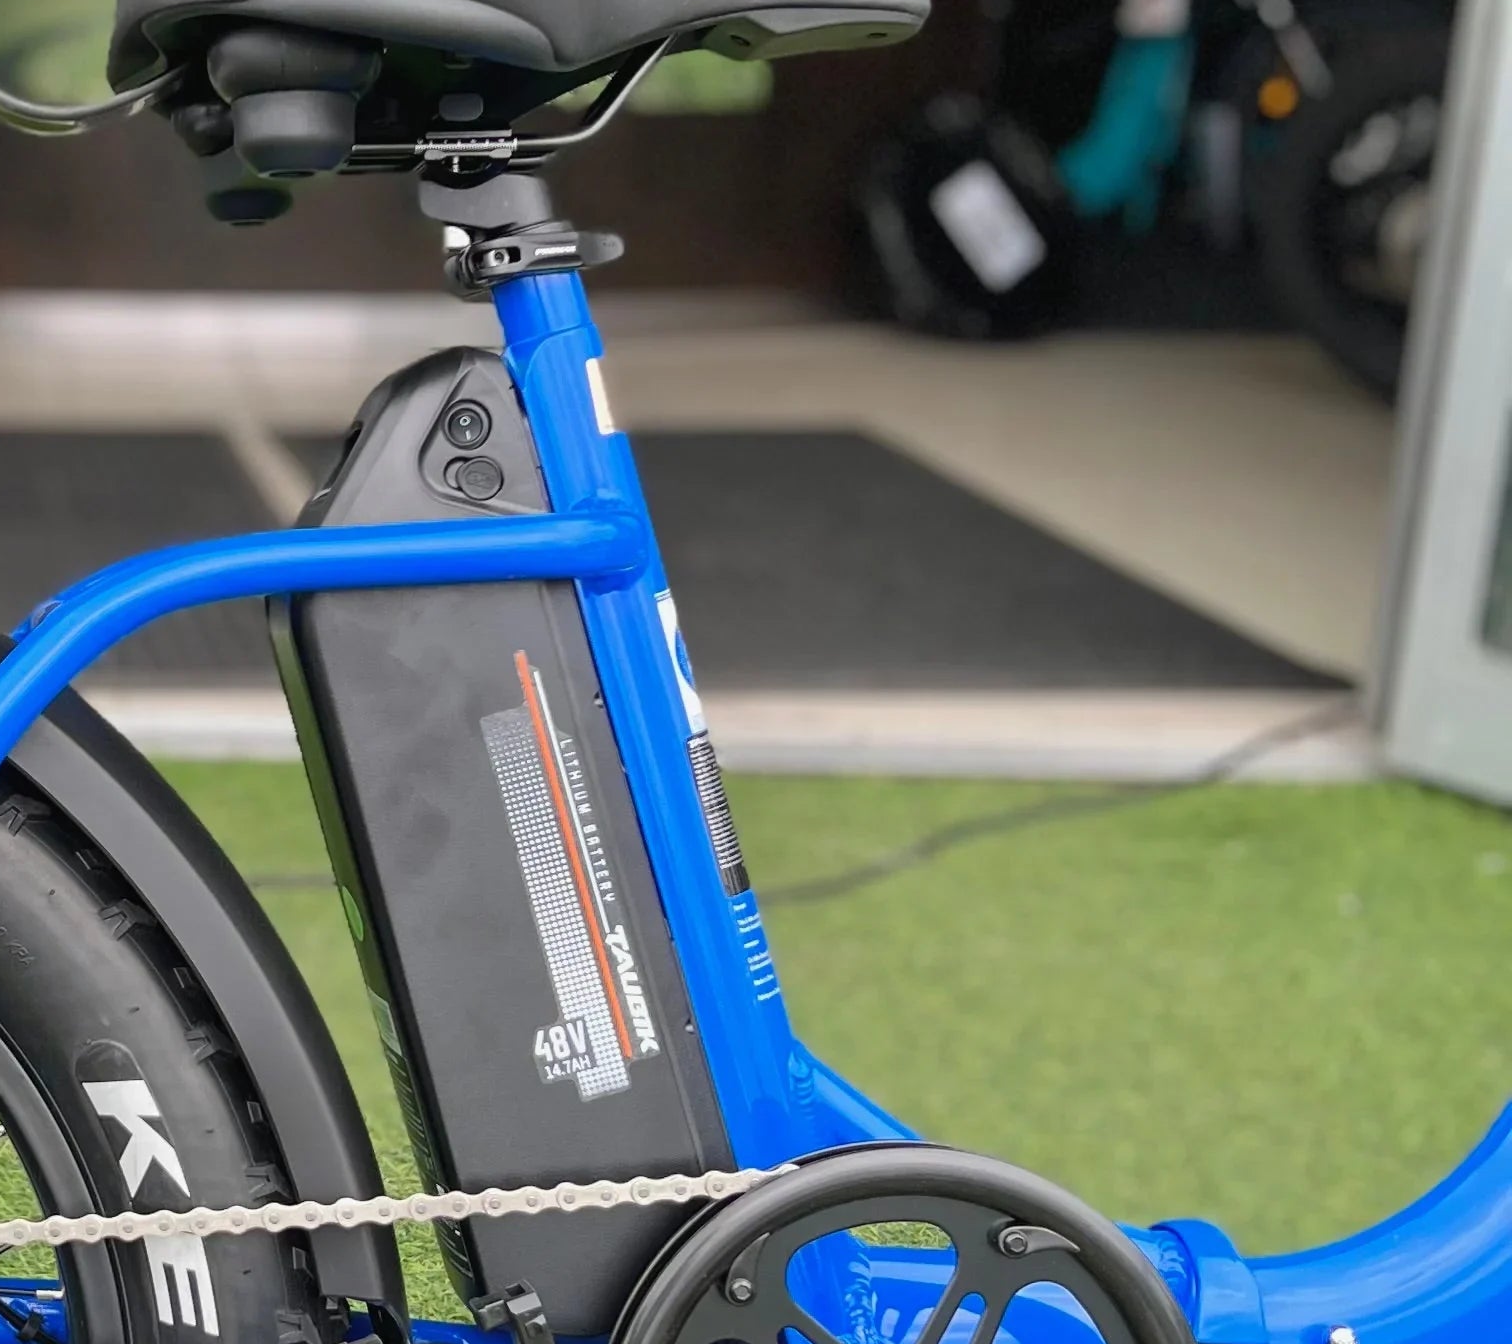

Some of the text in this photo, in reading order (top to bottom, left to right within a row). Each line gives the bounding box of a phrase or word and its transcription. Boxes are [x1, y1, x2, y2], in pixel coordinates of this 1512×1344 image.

[560, 738, 615, 902] LITHIUM BATTERY
[534, 1019, 587, 1062] 48V
[544, 1056, 592, 1080] 14.7AH
